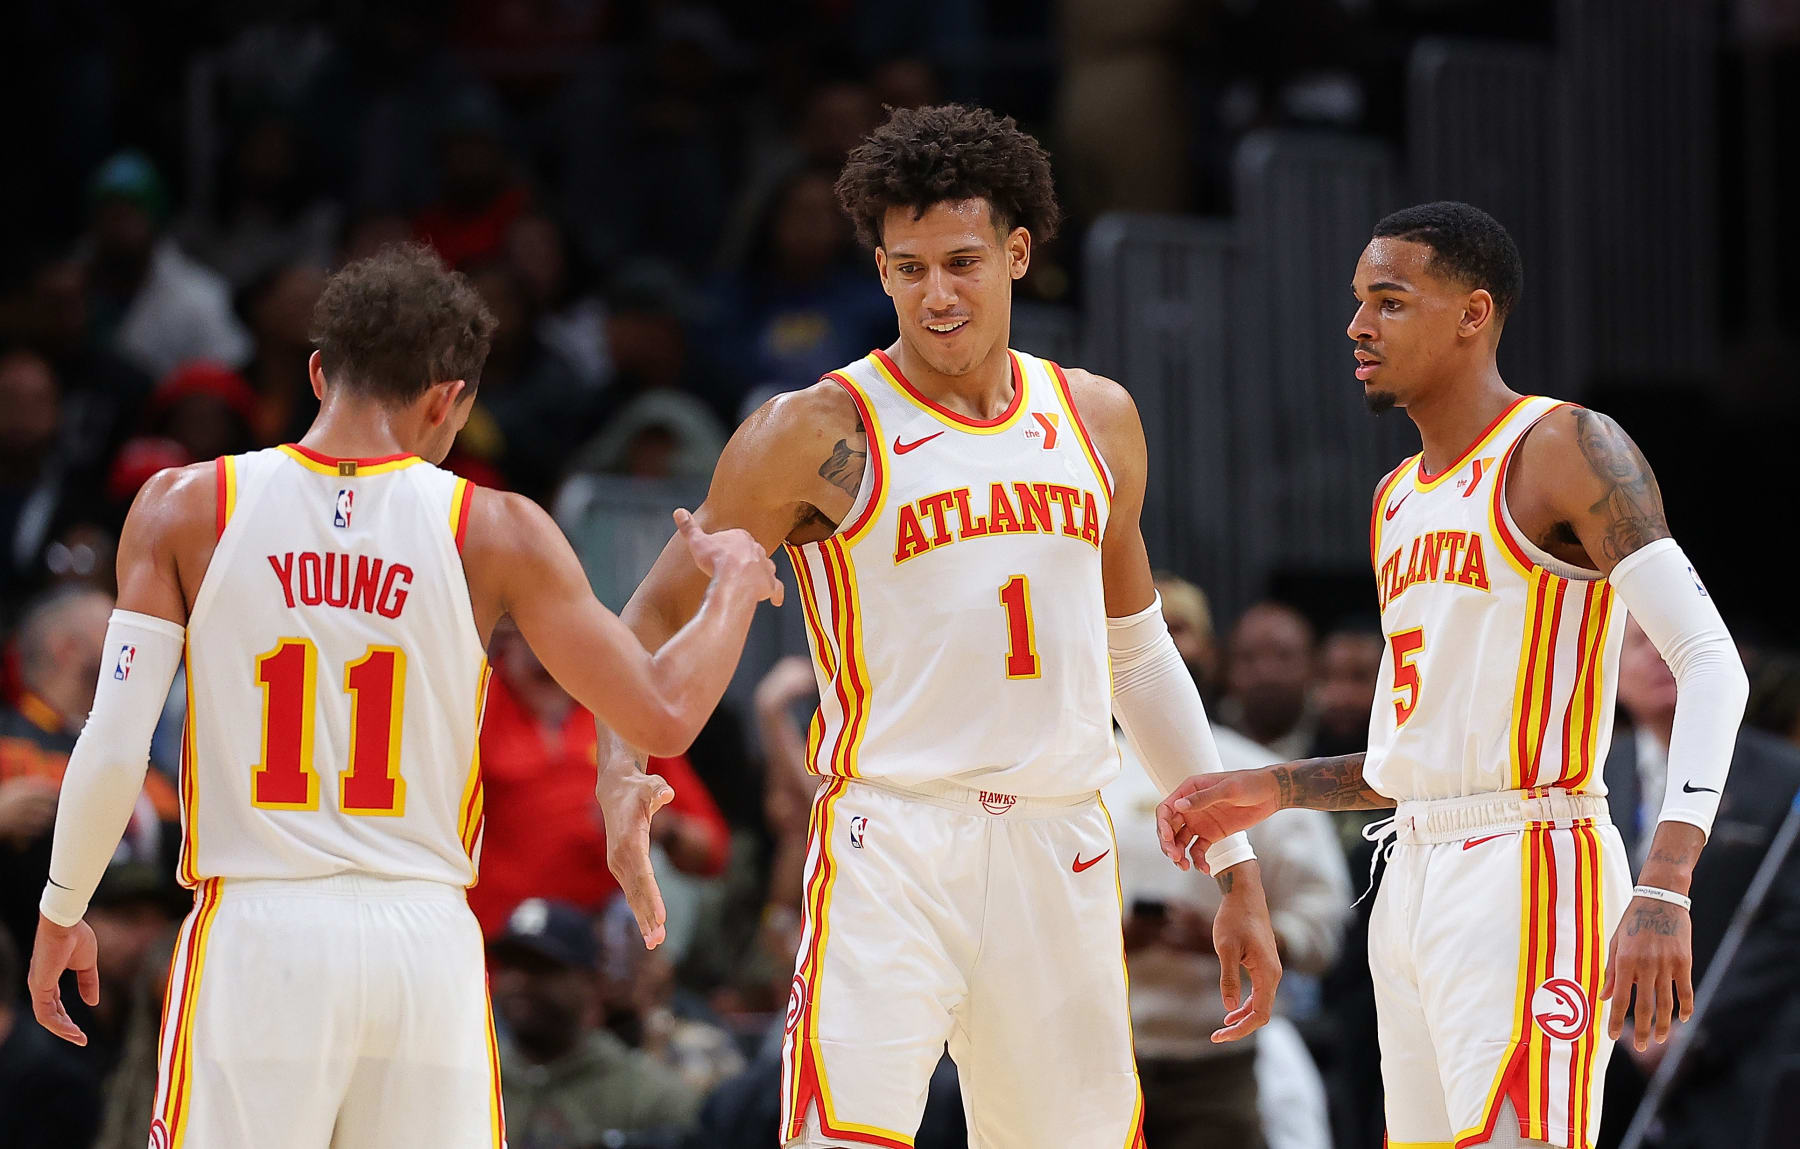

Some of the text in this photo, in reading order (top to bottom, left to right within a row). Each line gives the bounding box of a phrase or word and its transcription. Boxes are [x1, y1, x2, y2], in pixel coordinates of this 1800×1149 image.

[1025, 429, 1041, 439] the
[893, 481, 1100, 567] ATLANTA
[267, 552, 414, 620] YOUNG
[1378, 529, 1491, 616] TLANTA
[999, 574, 1042, 680] 1
[1388, 624, 1425, 731] 5
[251, 636, 407, 817] 11
[978, 790, 1017, 805] HAWKS
